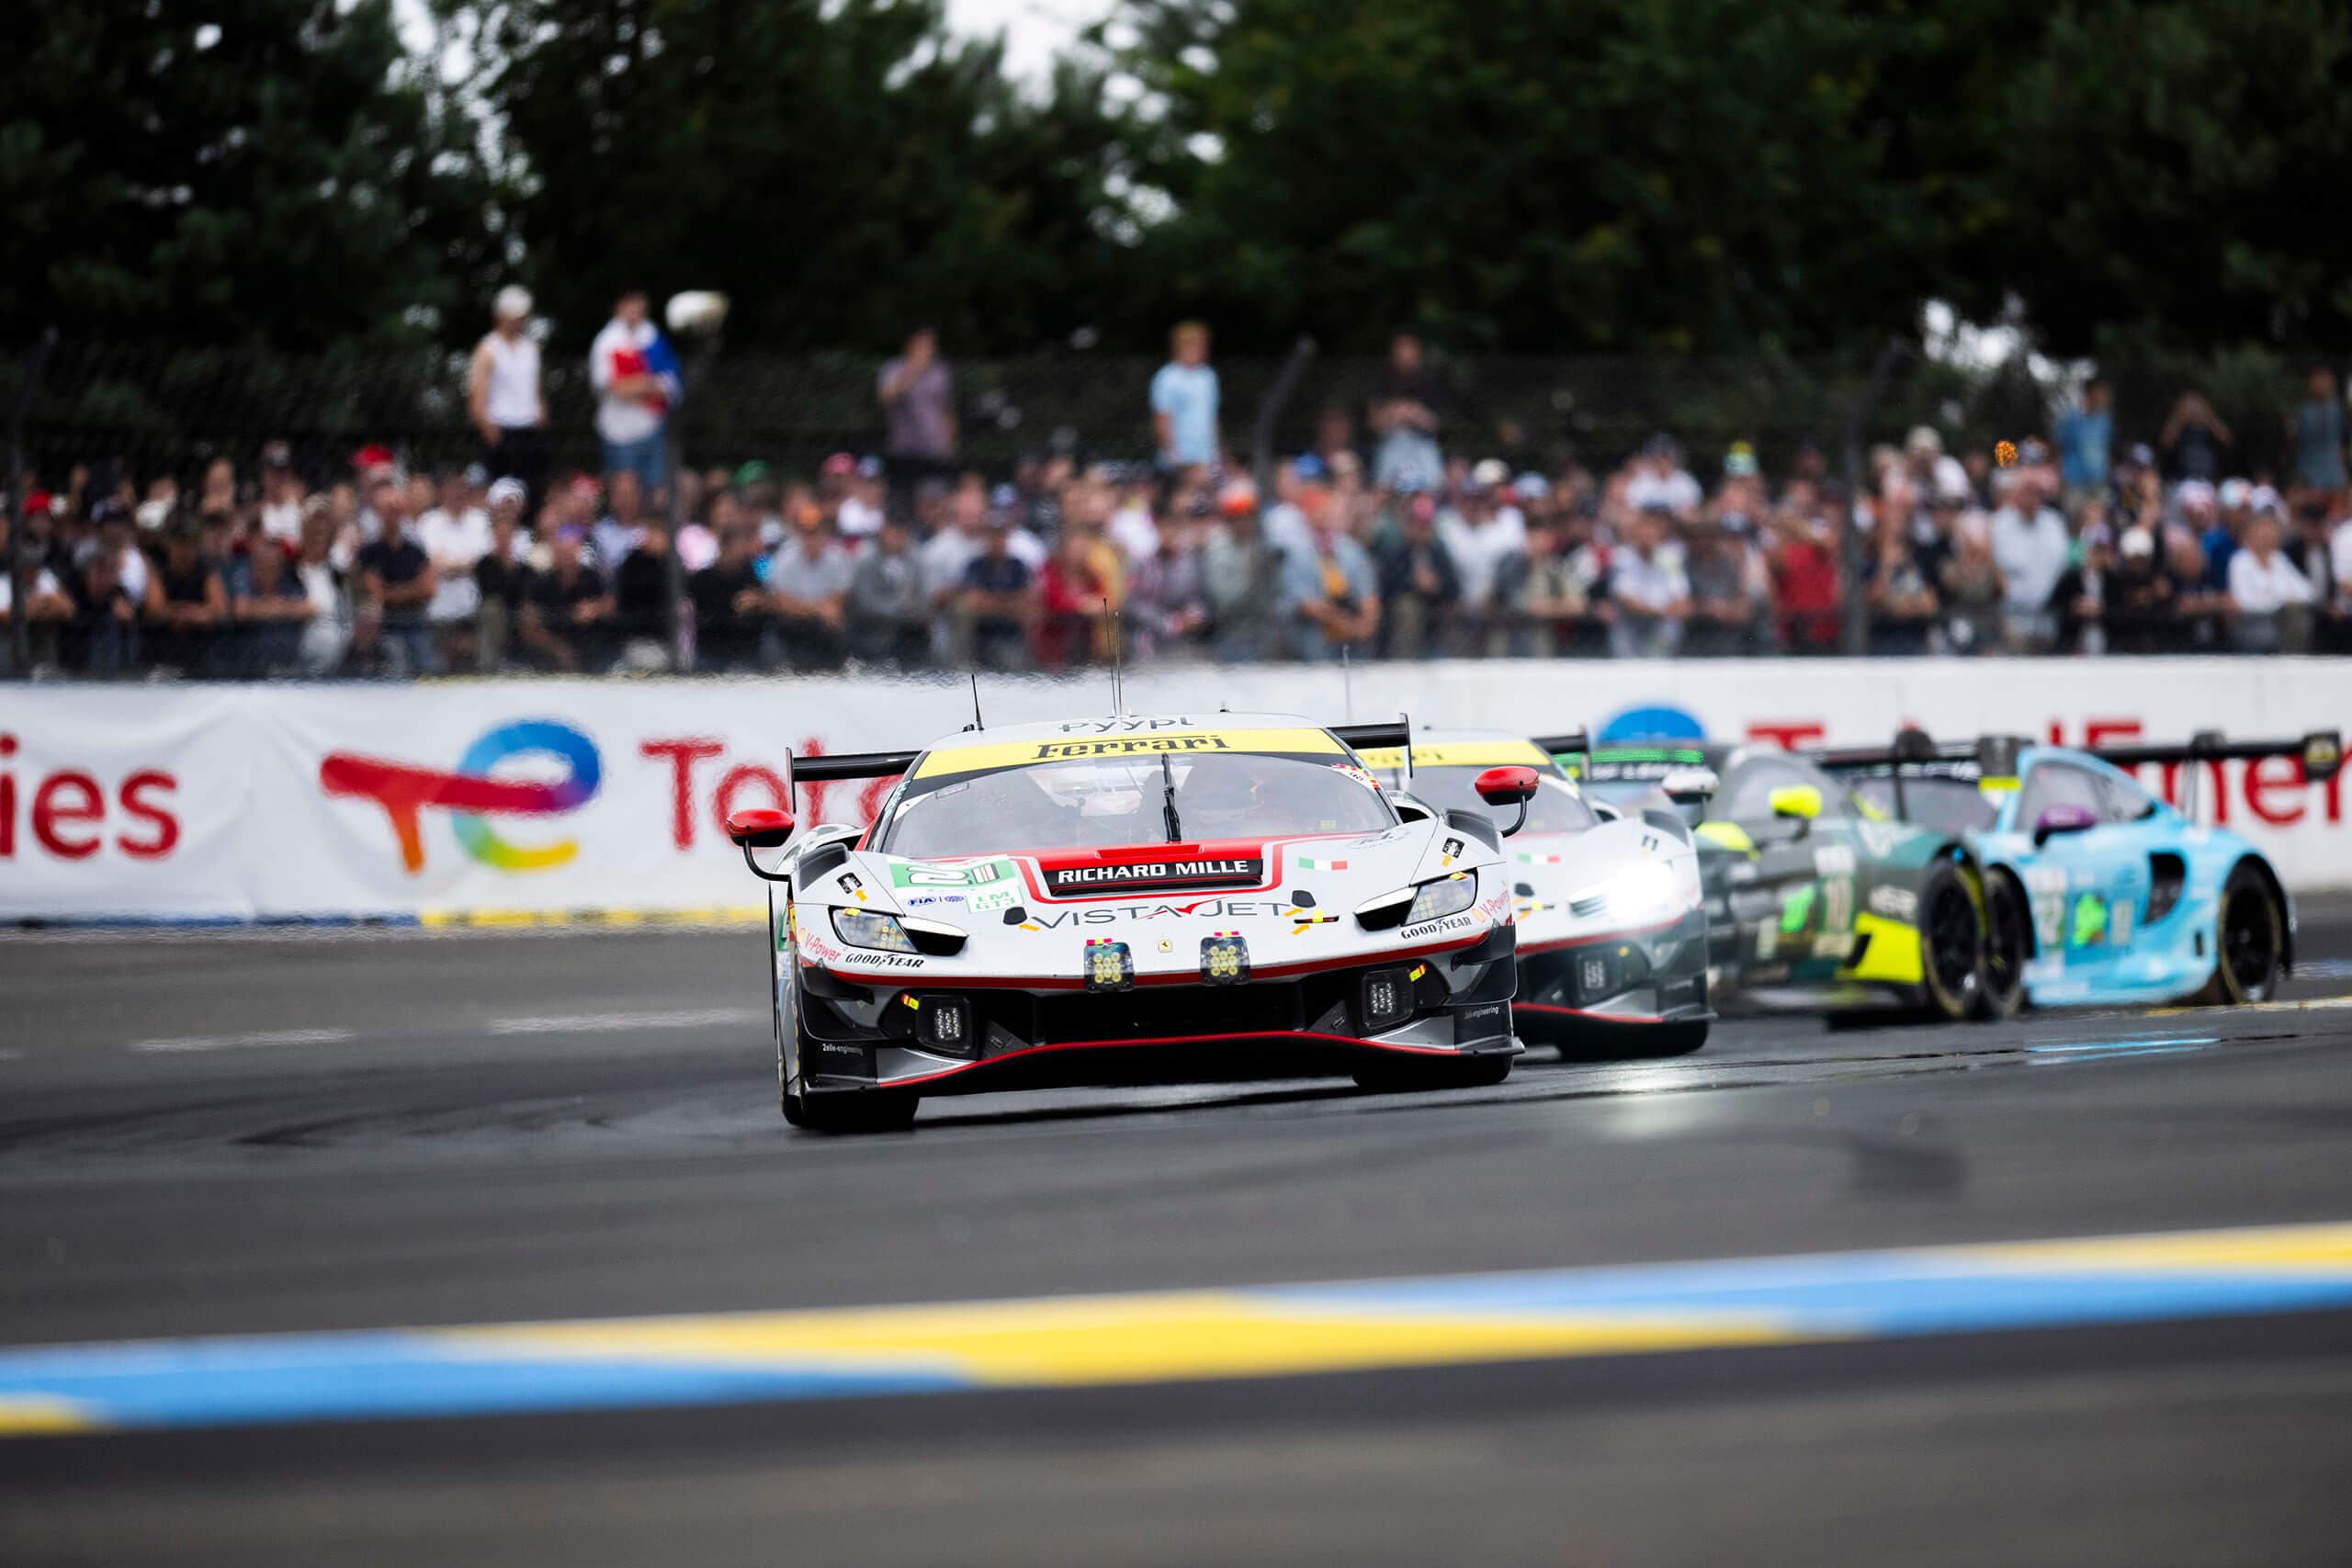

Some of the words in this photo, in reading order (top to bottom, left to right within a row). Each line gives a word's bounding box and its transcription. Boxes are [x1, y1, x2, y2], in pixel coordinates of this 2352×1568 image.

[1031, 736, 1230, 760] Ferrari
[0, 733, 179, 860] ies
[1057, 862, 1166, 884] RICHARD
[1176, 860, 1250, 874] MILLE
[909, 897, 935, 906] FIA
[976, 897, 1015, 910] GT3
[977, 890, 1010, 902] LM
[1400, 917, 1472, 939] GOODYEAR
[845, 953, 924, 969] GOODYEAR
